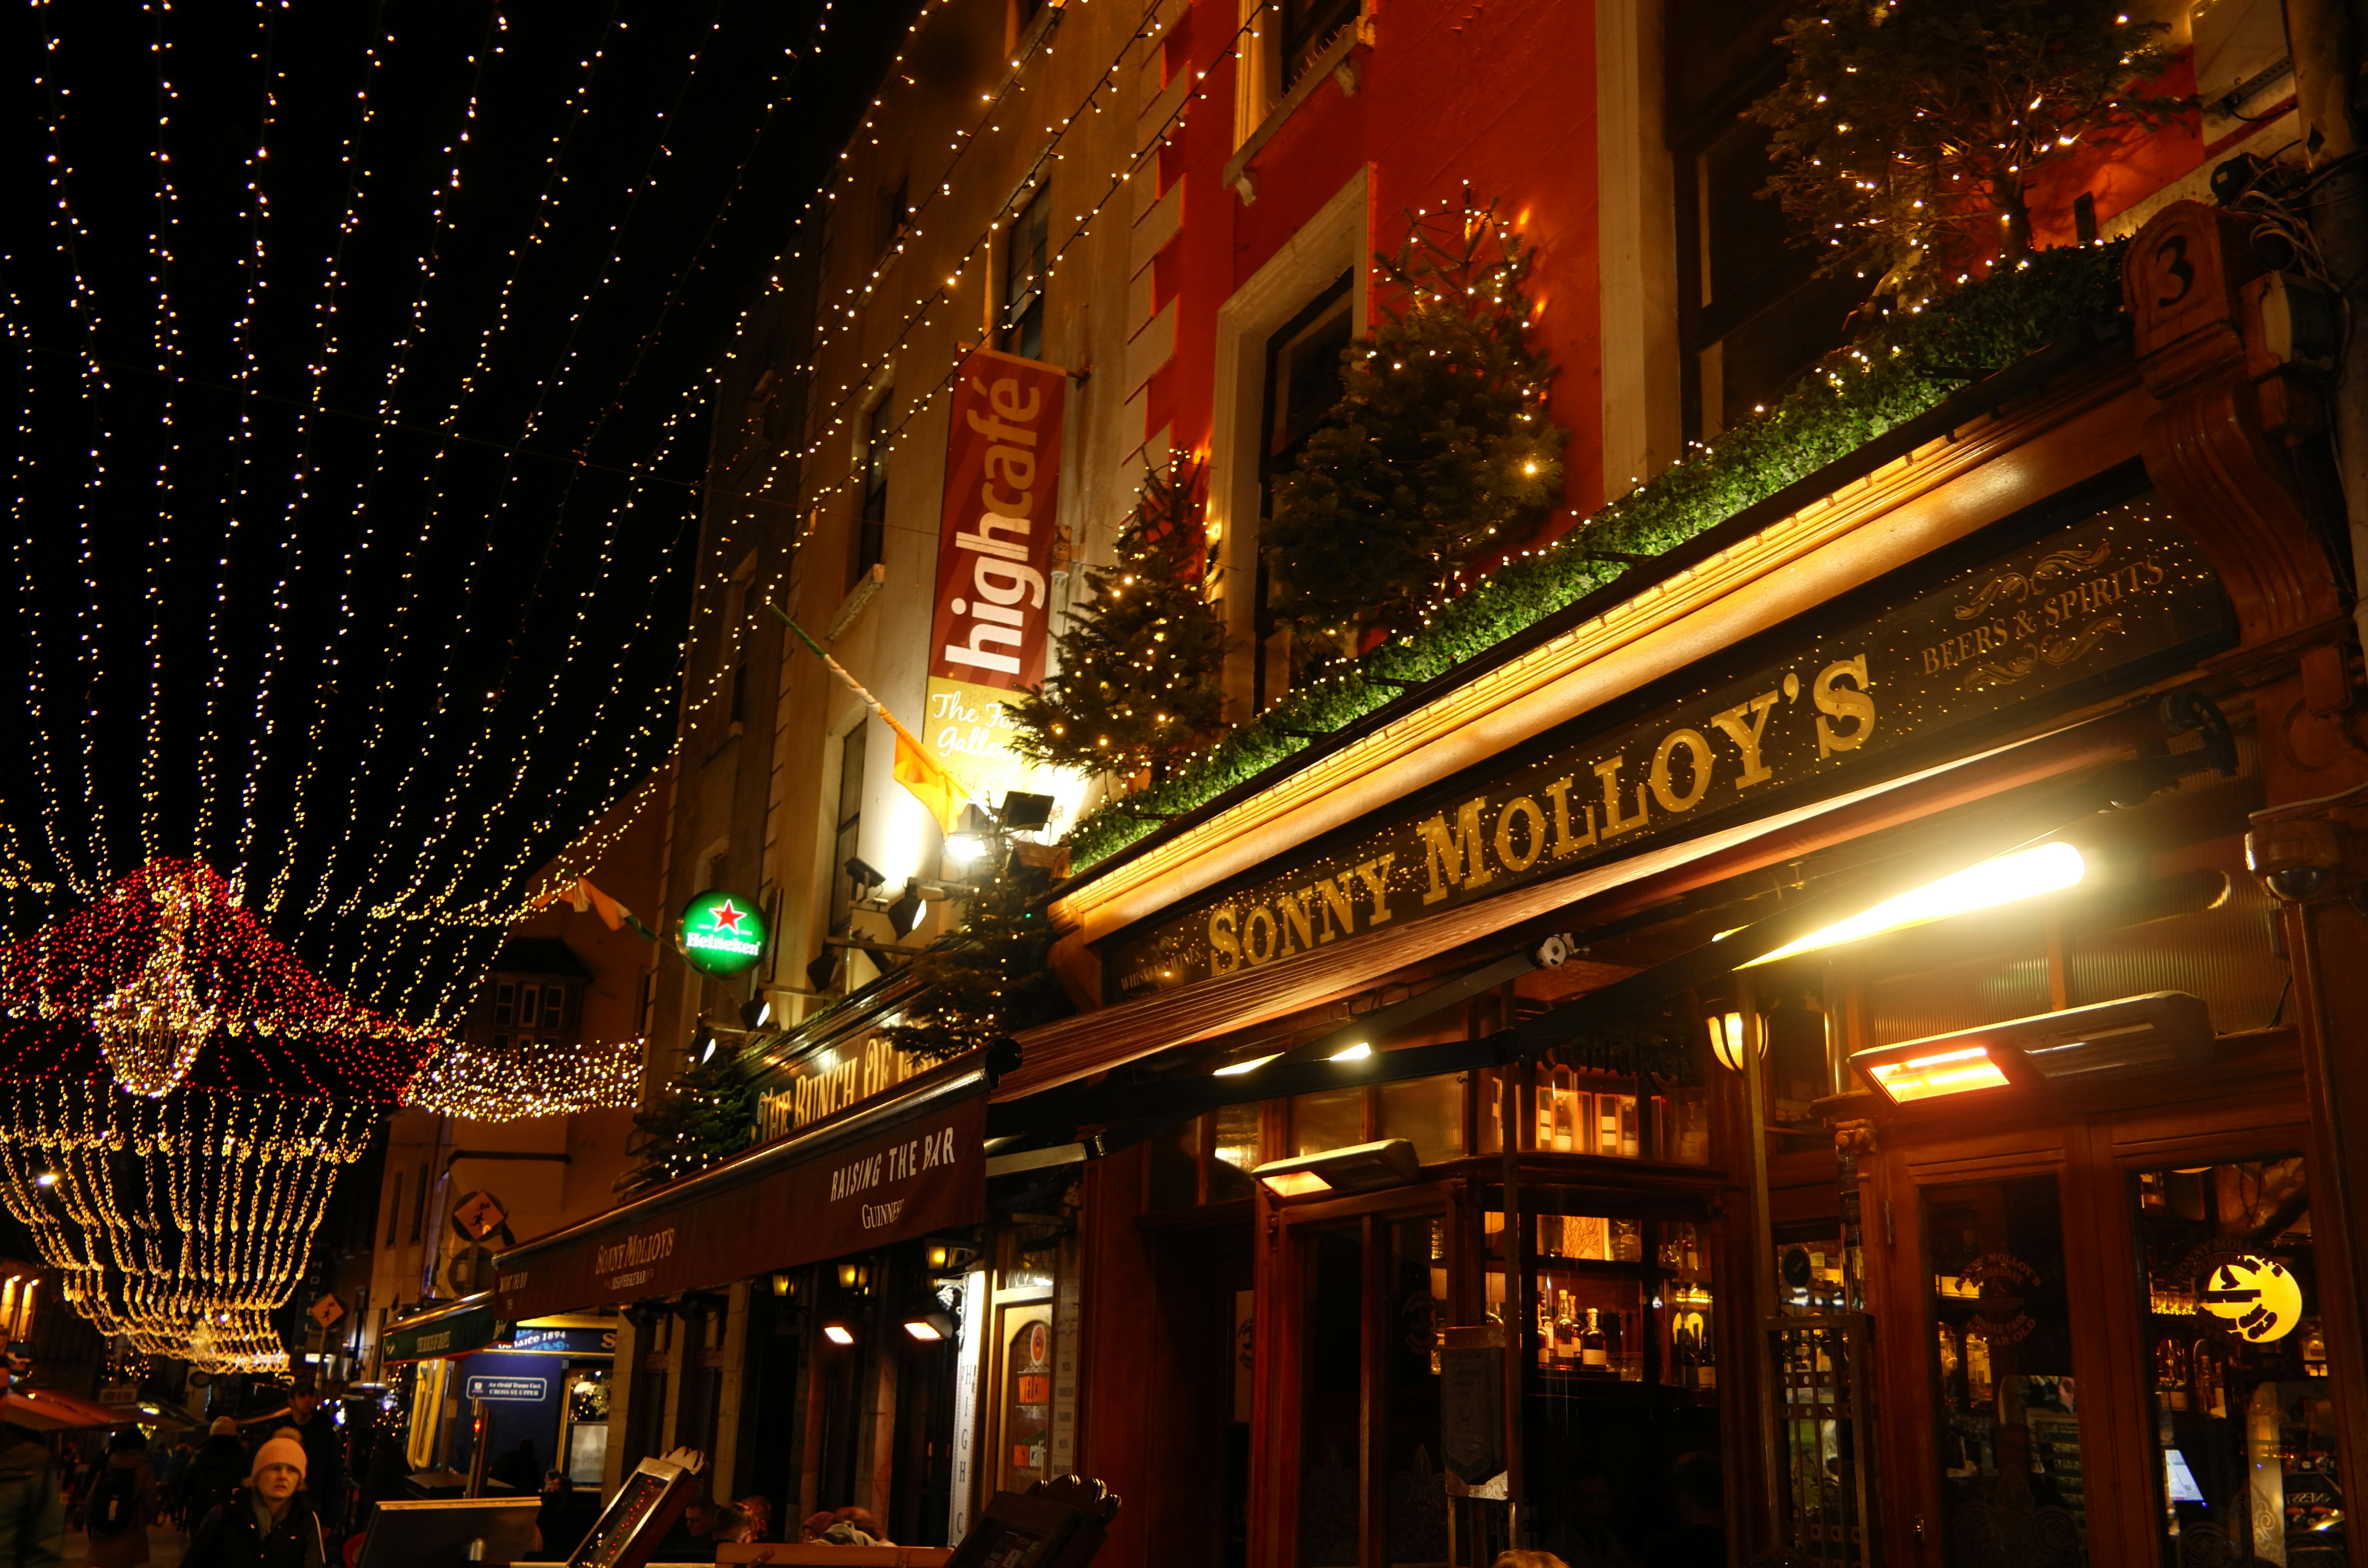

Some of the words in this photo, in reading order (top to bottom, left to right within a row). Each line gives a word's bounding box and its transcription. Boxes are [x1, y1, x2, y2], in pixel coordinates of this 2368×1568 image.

[2156, 234, 2195, 307] 3
[1921, 618, 2009, 676] BEERS
[2015, 610, 2037, 637] &
[2044, 555, 2164, 626] SPIRITS
[932, 690, 980, 723] The
[937, 726, 1023, 770] Gallery
[1207, 852, 1396, 977] SONNY
[1415, 652, 1877, 907] MOLLOY'S
[686, 932, 760, 956] Heineken
[757, 1087, 792, 1143] THE
[794, 1057, 858, 1130] BUNCH
[864, 1038, 893, 1099] OF
[830, 1152, 883, 1202] RAISING
[888, 1140, 918, 1182] THE
[922, 1127, 956, 1171] BAR
[595, 1245, 626, 1275] SONNY
[542, 1331, 566, 1342] 1894
[2013, 1318, 2036, 1342] OLD
